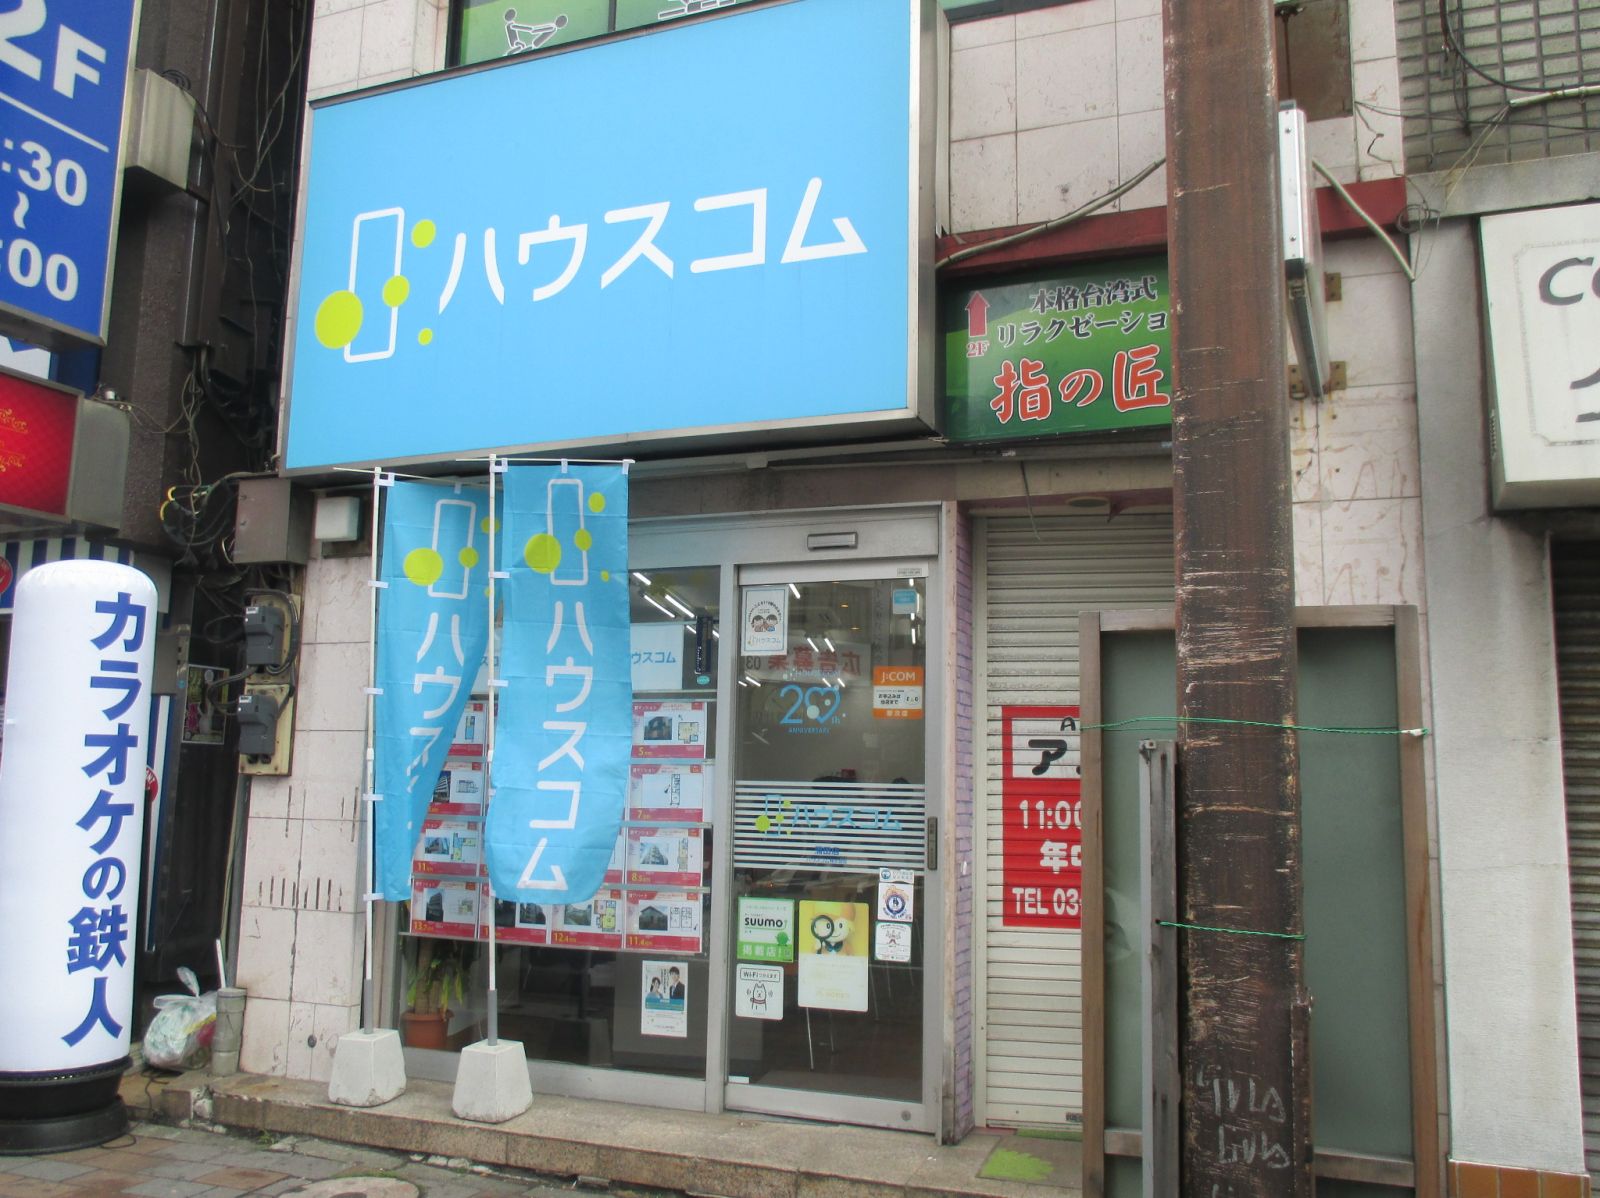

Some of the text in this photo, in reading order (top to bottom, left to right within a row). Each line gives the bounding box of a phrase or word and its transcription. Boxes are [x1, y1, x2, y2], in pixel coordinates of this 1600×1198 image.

[0, 0, 107, 99] 2F
[437, 177, 868, 314] ハウスコム
[1030, 275, 1158, 314] 本格台湾式
[966, 341, 990, 357] 2F
[990, 344, 1171, 424] 指の匠
[516, 601, 595, 890] ハウスコム
[62, 591, 148, 1048] カラオケの鉄人
[744, 915, 783, 930] suumo
[1012, 887, 1049, 914] TEL
